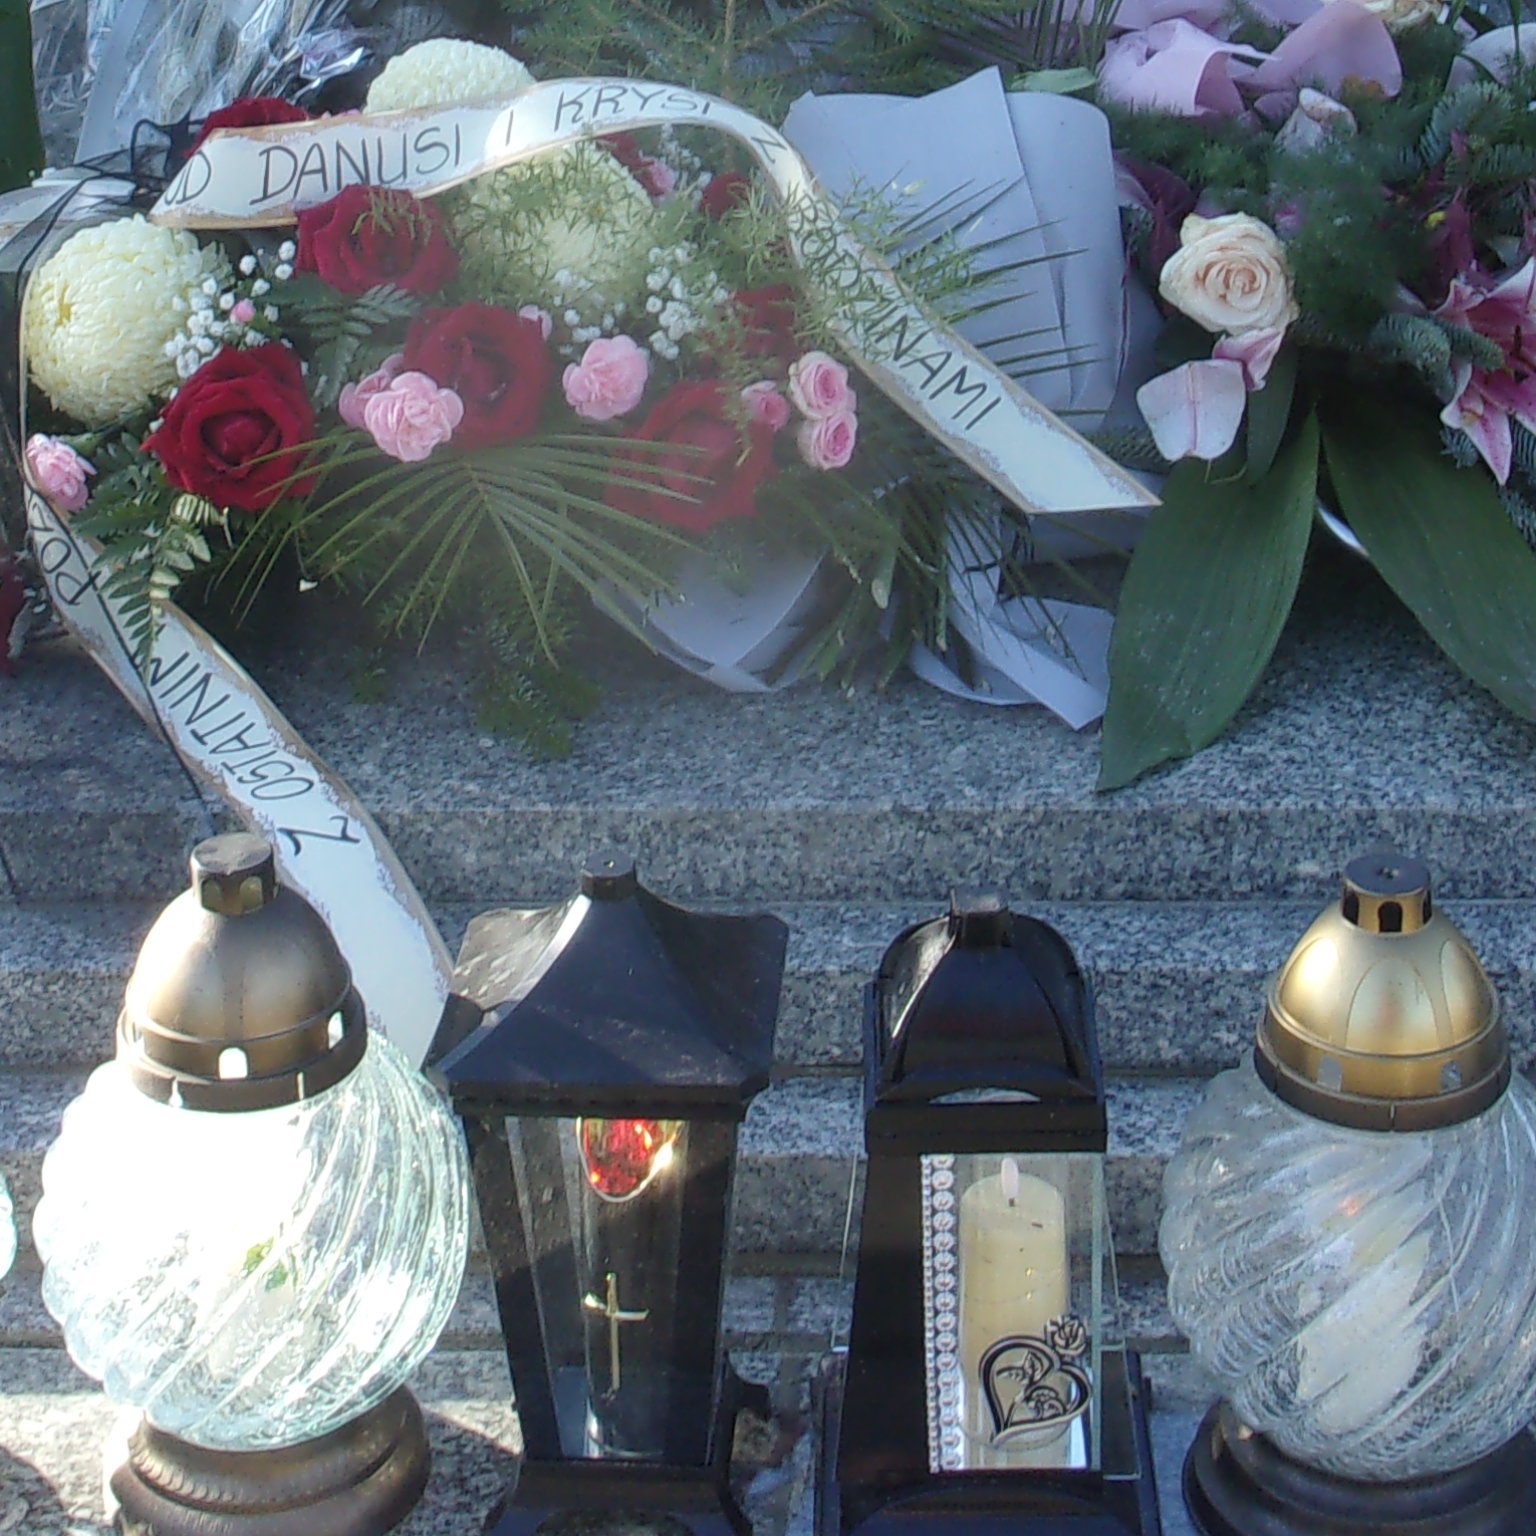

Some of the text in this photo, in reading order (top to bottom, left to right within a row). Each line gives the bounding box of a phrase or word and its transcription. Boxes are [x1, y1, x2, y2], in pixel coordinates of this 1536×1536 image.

[249, 122, 462, 207] DANUSI
[505, 108, 515, 146] I
[554, 84, 714, 133] KRYSI
